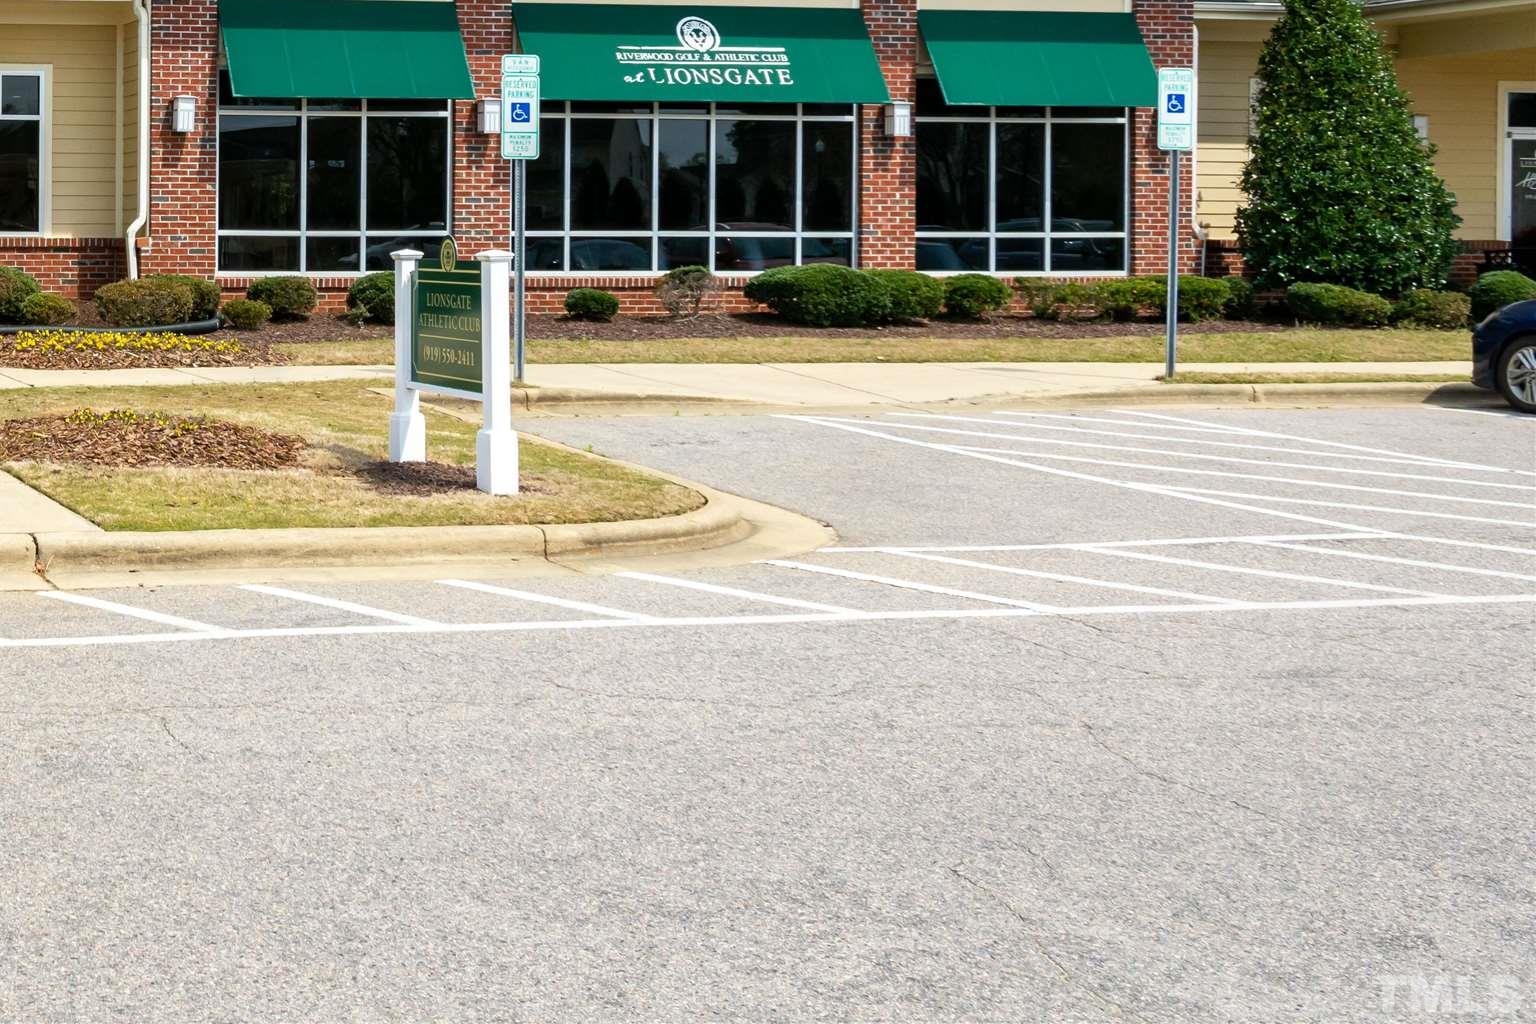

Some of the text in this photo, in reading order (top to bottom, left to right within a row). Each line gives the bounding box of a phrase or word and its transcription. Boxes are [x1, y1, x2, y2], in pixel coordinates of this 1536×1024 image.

[616, 52, 789, 62] RIVERWOOD GOLF & ATHLETIC CLUB
[624, 67, 794, 85] at LIONSGATE
[505, 80, 536, 88] RESERVED
[507, 90, 534, 98] PARKING
[426, 293, 471, 309] LIONSGATE
[418, 312, 481, 332] ATHLETIC CLUB
